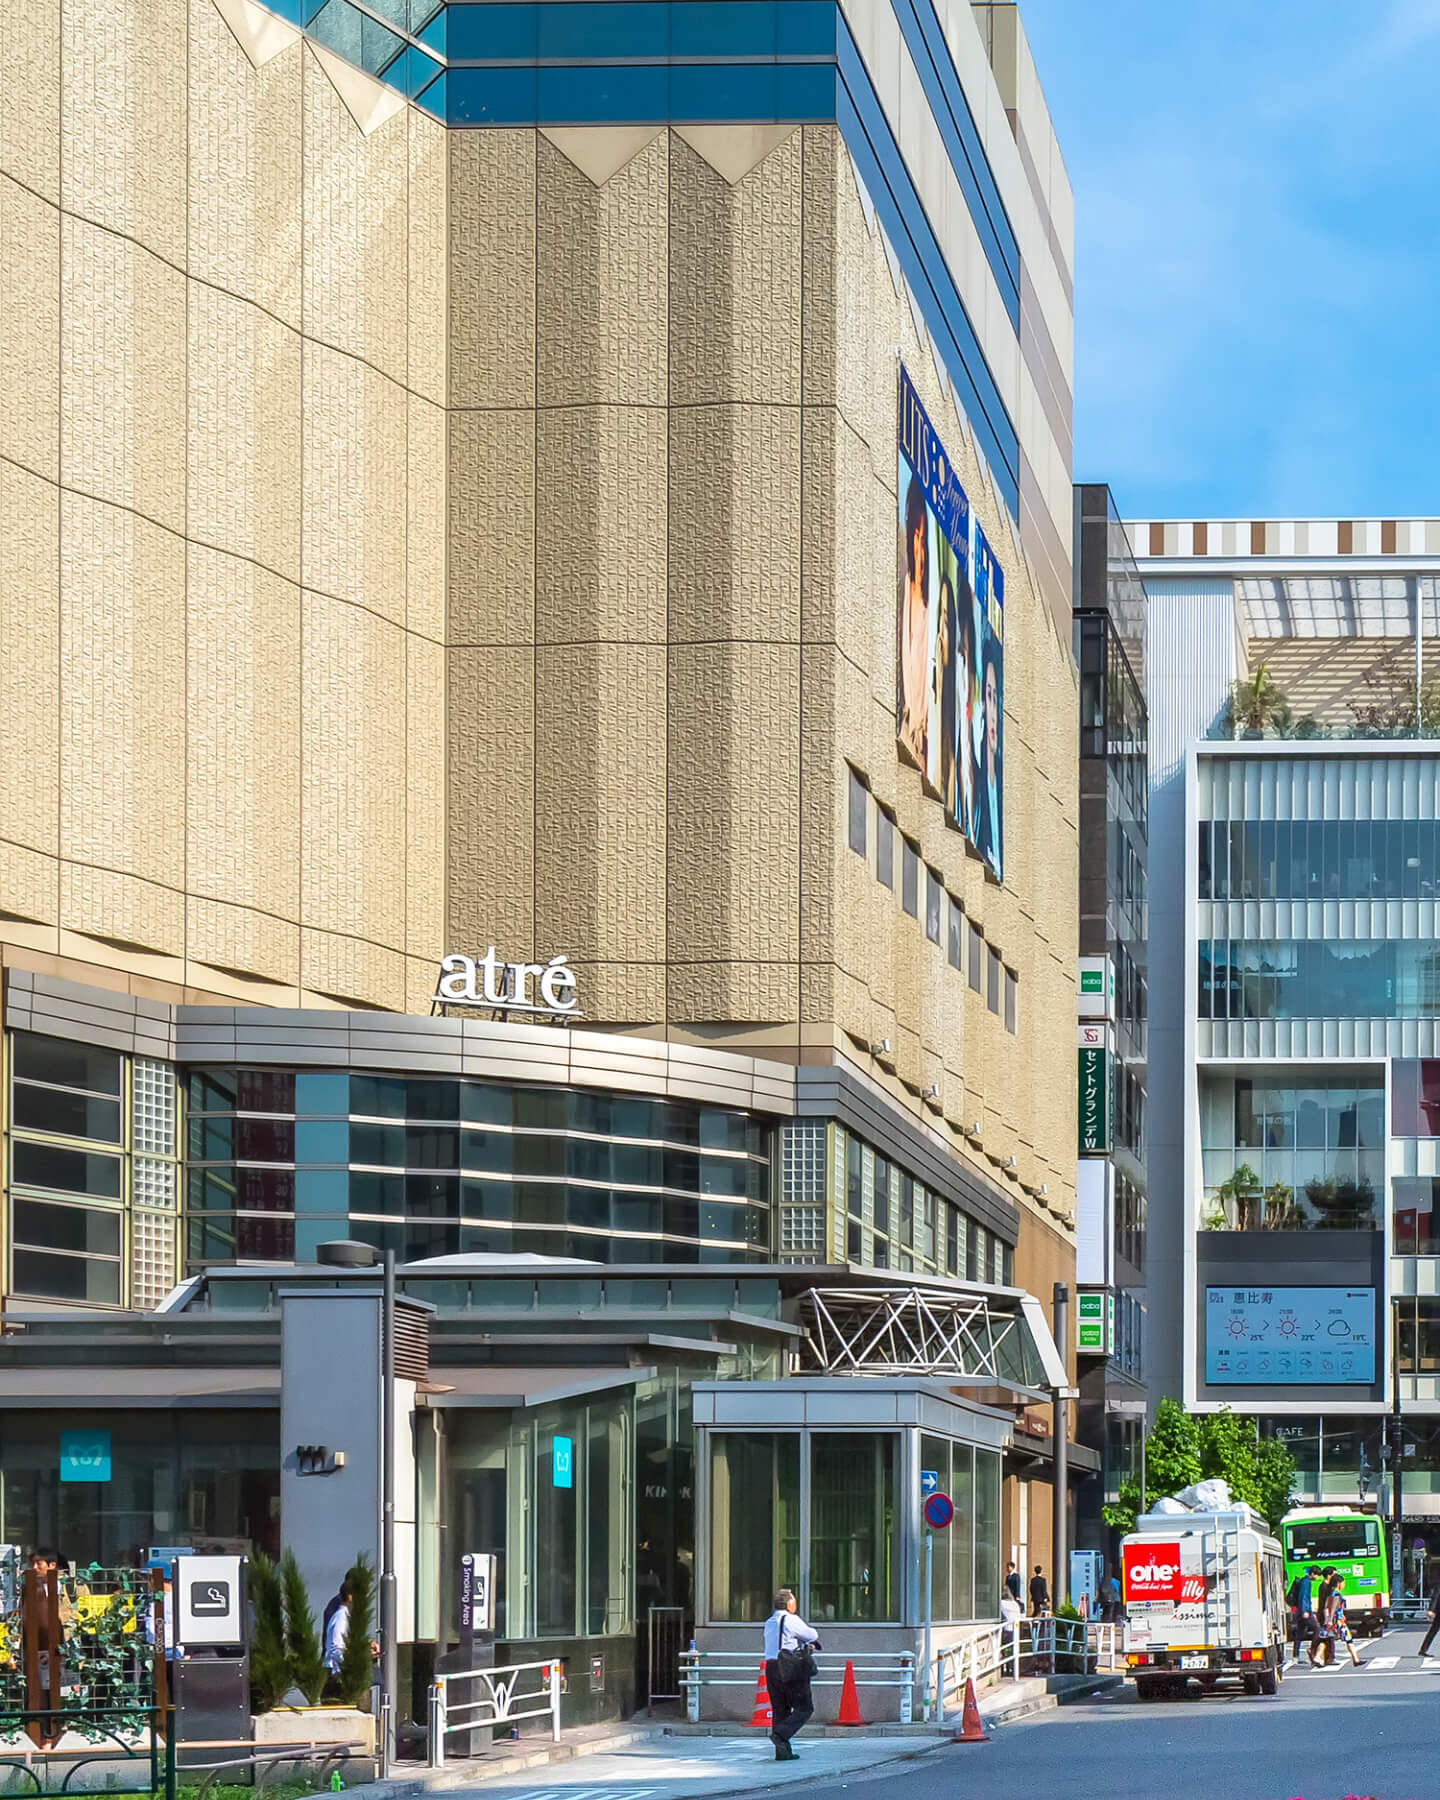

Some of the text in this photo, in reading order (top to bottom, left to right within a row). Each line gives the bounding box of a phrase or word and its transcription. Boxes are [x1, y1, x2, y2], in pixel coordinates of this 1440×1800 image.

[902, 379, 930, 488] LITS
[439, 945, 577, 1010] atré
[1084, 1049, 1097, 1149] セントグランデW
[1234, 1292, 1273, 1304] 恵比寿
[462, 1567, 472, 1603] Smoking
[1181, 1580, 1205, 1600] illy
